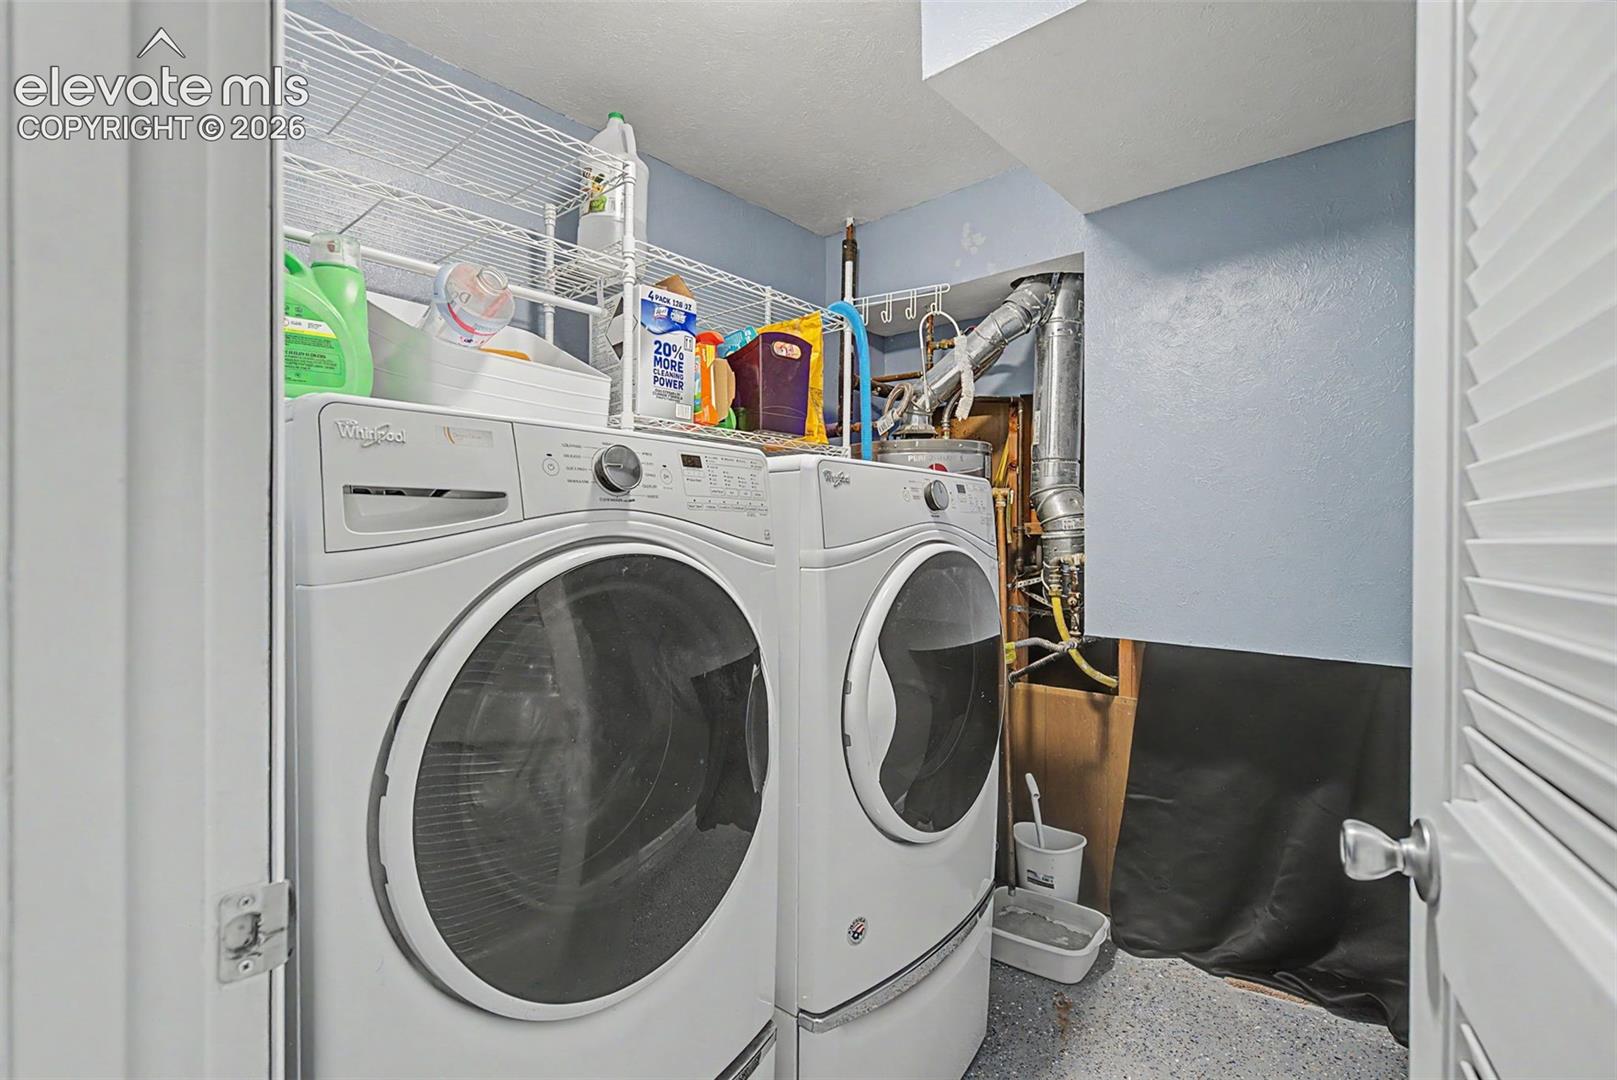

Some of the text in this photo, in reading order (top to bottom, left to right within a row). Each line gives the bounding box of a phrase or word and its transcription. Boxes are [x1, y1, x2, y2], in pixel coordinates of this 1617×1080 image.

[648, 290, 654, 301] 4
[655, 294, 671, 305] PACK
[654, 340, 684, 361] 20%
[653, 355, 684, 373] MORE
[653, 368, 684, 381] CLEANING
[653, 376, 684, 391] POWER
[335, 419, 406, 448] Whirlpool
